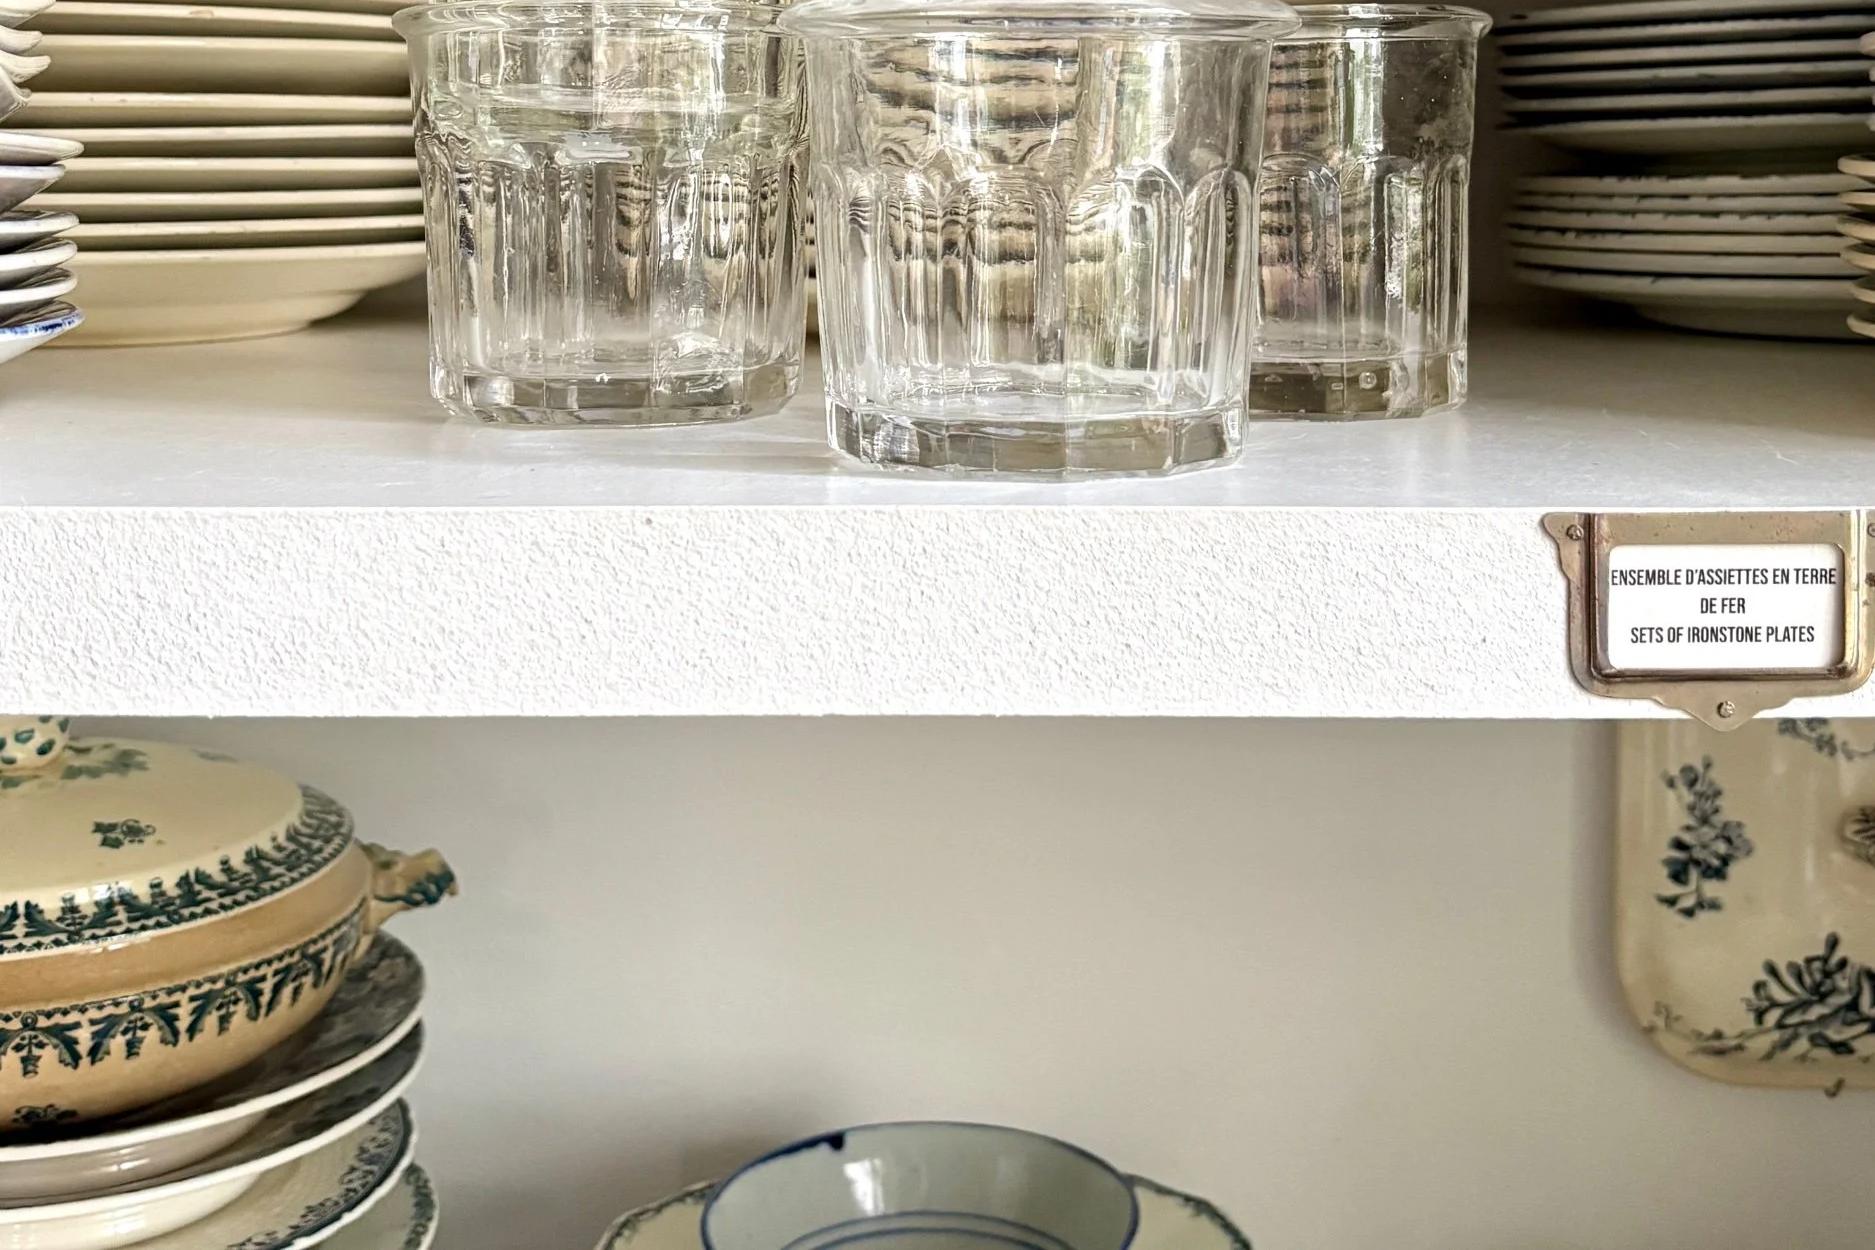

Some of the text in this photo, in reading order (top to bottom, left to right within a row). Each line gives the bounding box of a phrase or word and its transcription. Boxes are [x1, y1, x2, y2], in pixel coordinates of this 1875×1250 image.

[1611, 568, 1837, 586] ENSEMBLE D'ASSIETTES EN TERRE
[1700, 597, 1746, 614] DE FER
[1630, 625, 1815, 644] SETS OF IRONSTONE PLATES
